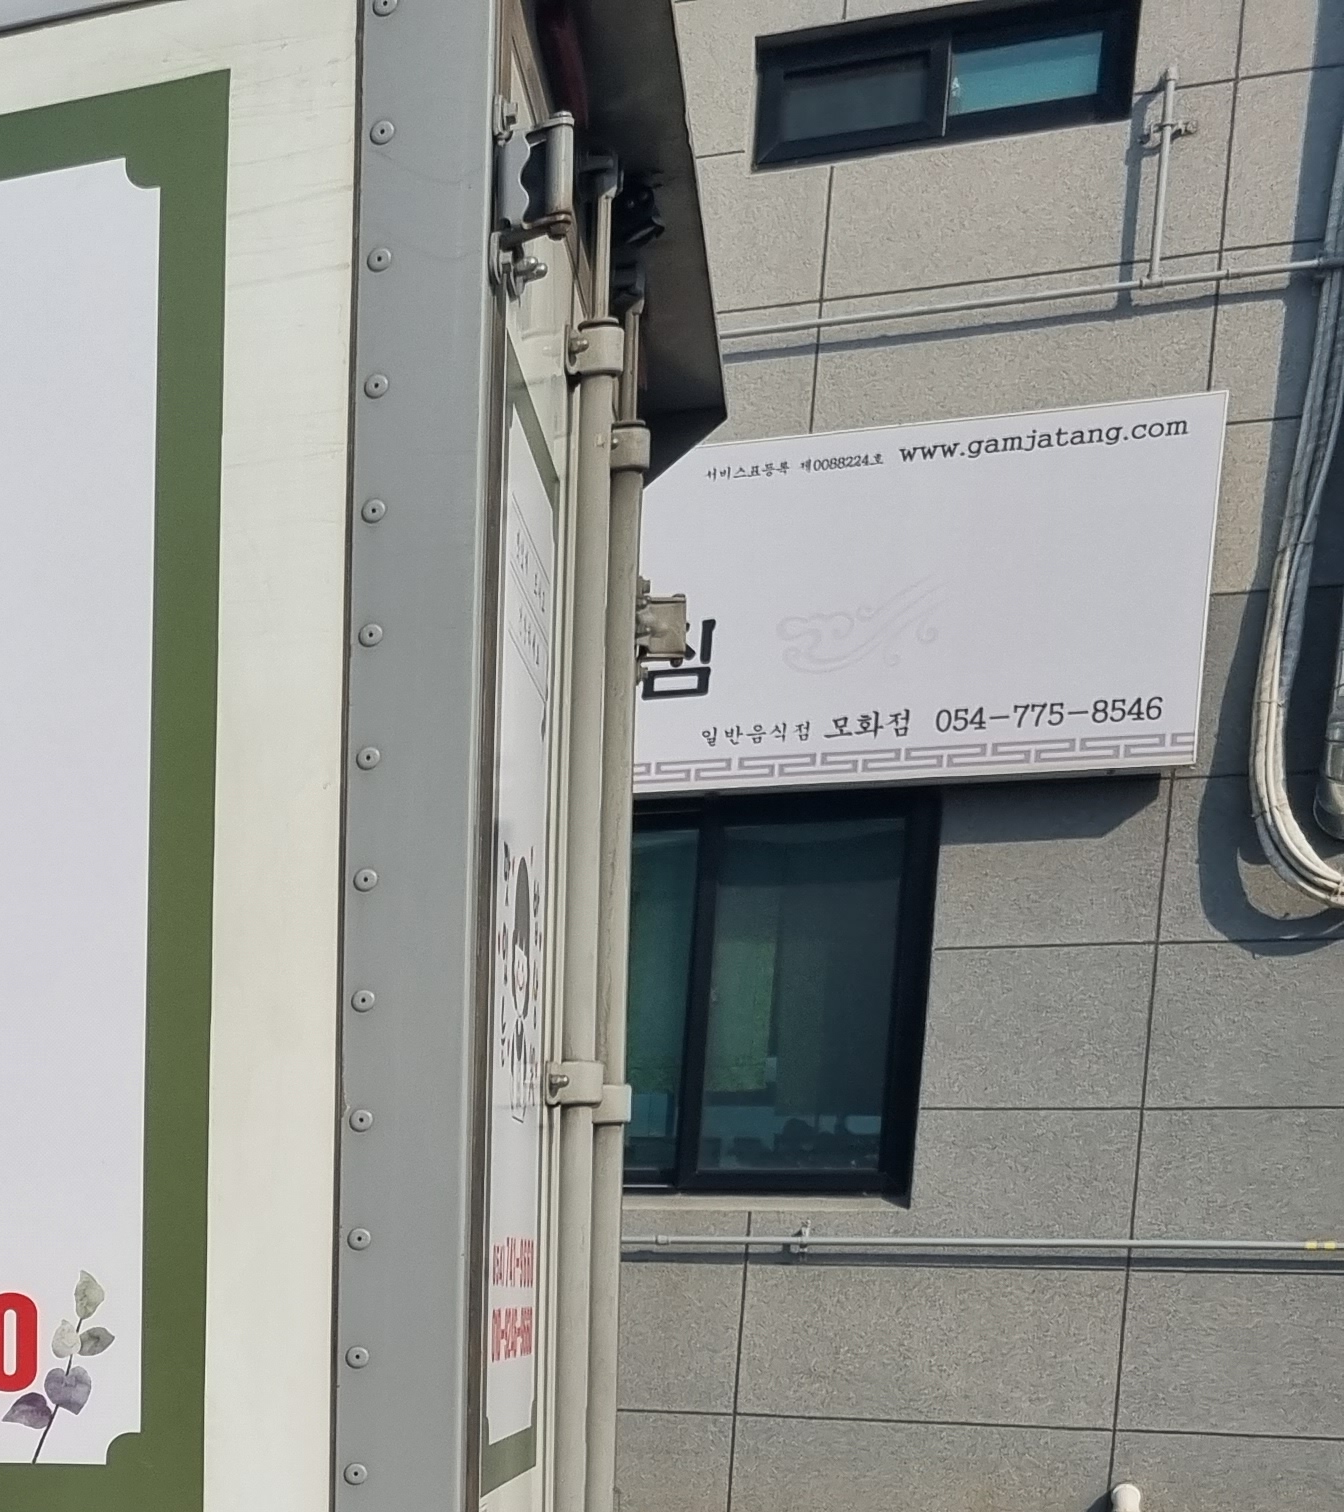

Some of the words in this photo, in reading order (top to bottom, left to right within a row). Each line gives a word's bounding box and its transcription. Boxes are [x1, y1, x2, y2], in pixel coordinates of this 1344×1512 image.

[898, 419, 1189, 463] www.gamjatang.com
[705, 460, 790, 481] 서비스표등록
[800, 453, 885, 474] 제0088224호
[701, 719, 812, 747] 일반음식점
[823, 708, 911, 740] 모화점
[935, 696, 1165, 733] 054-775-8546
